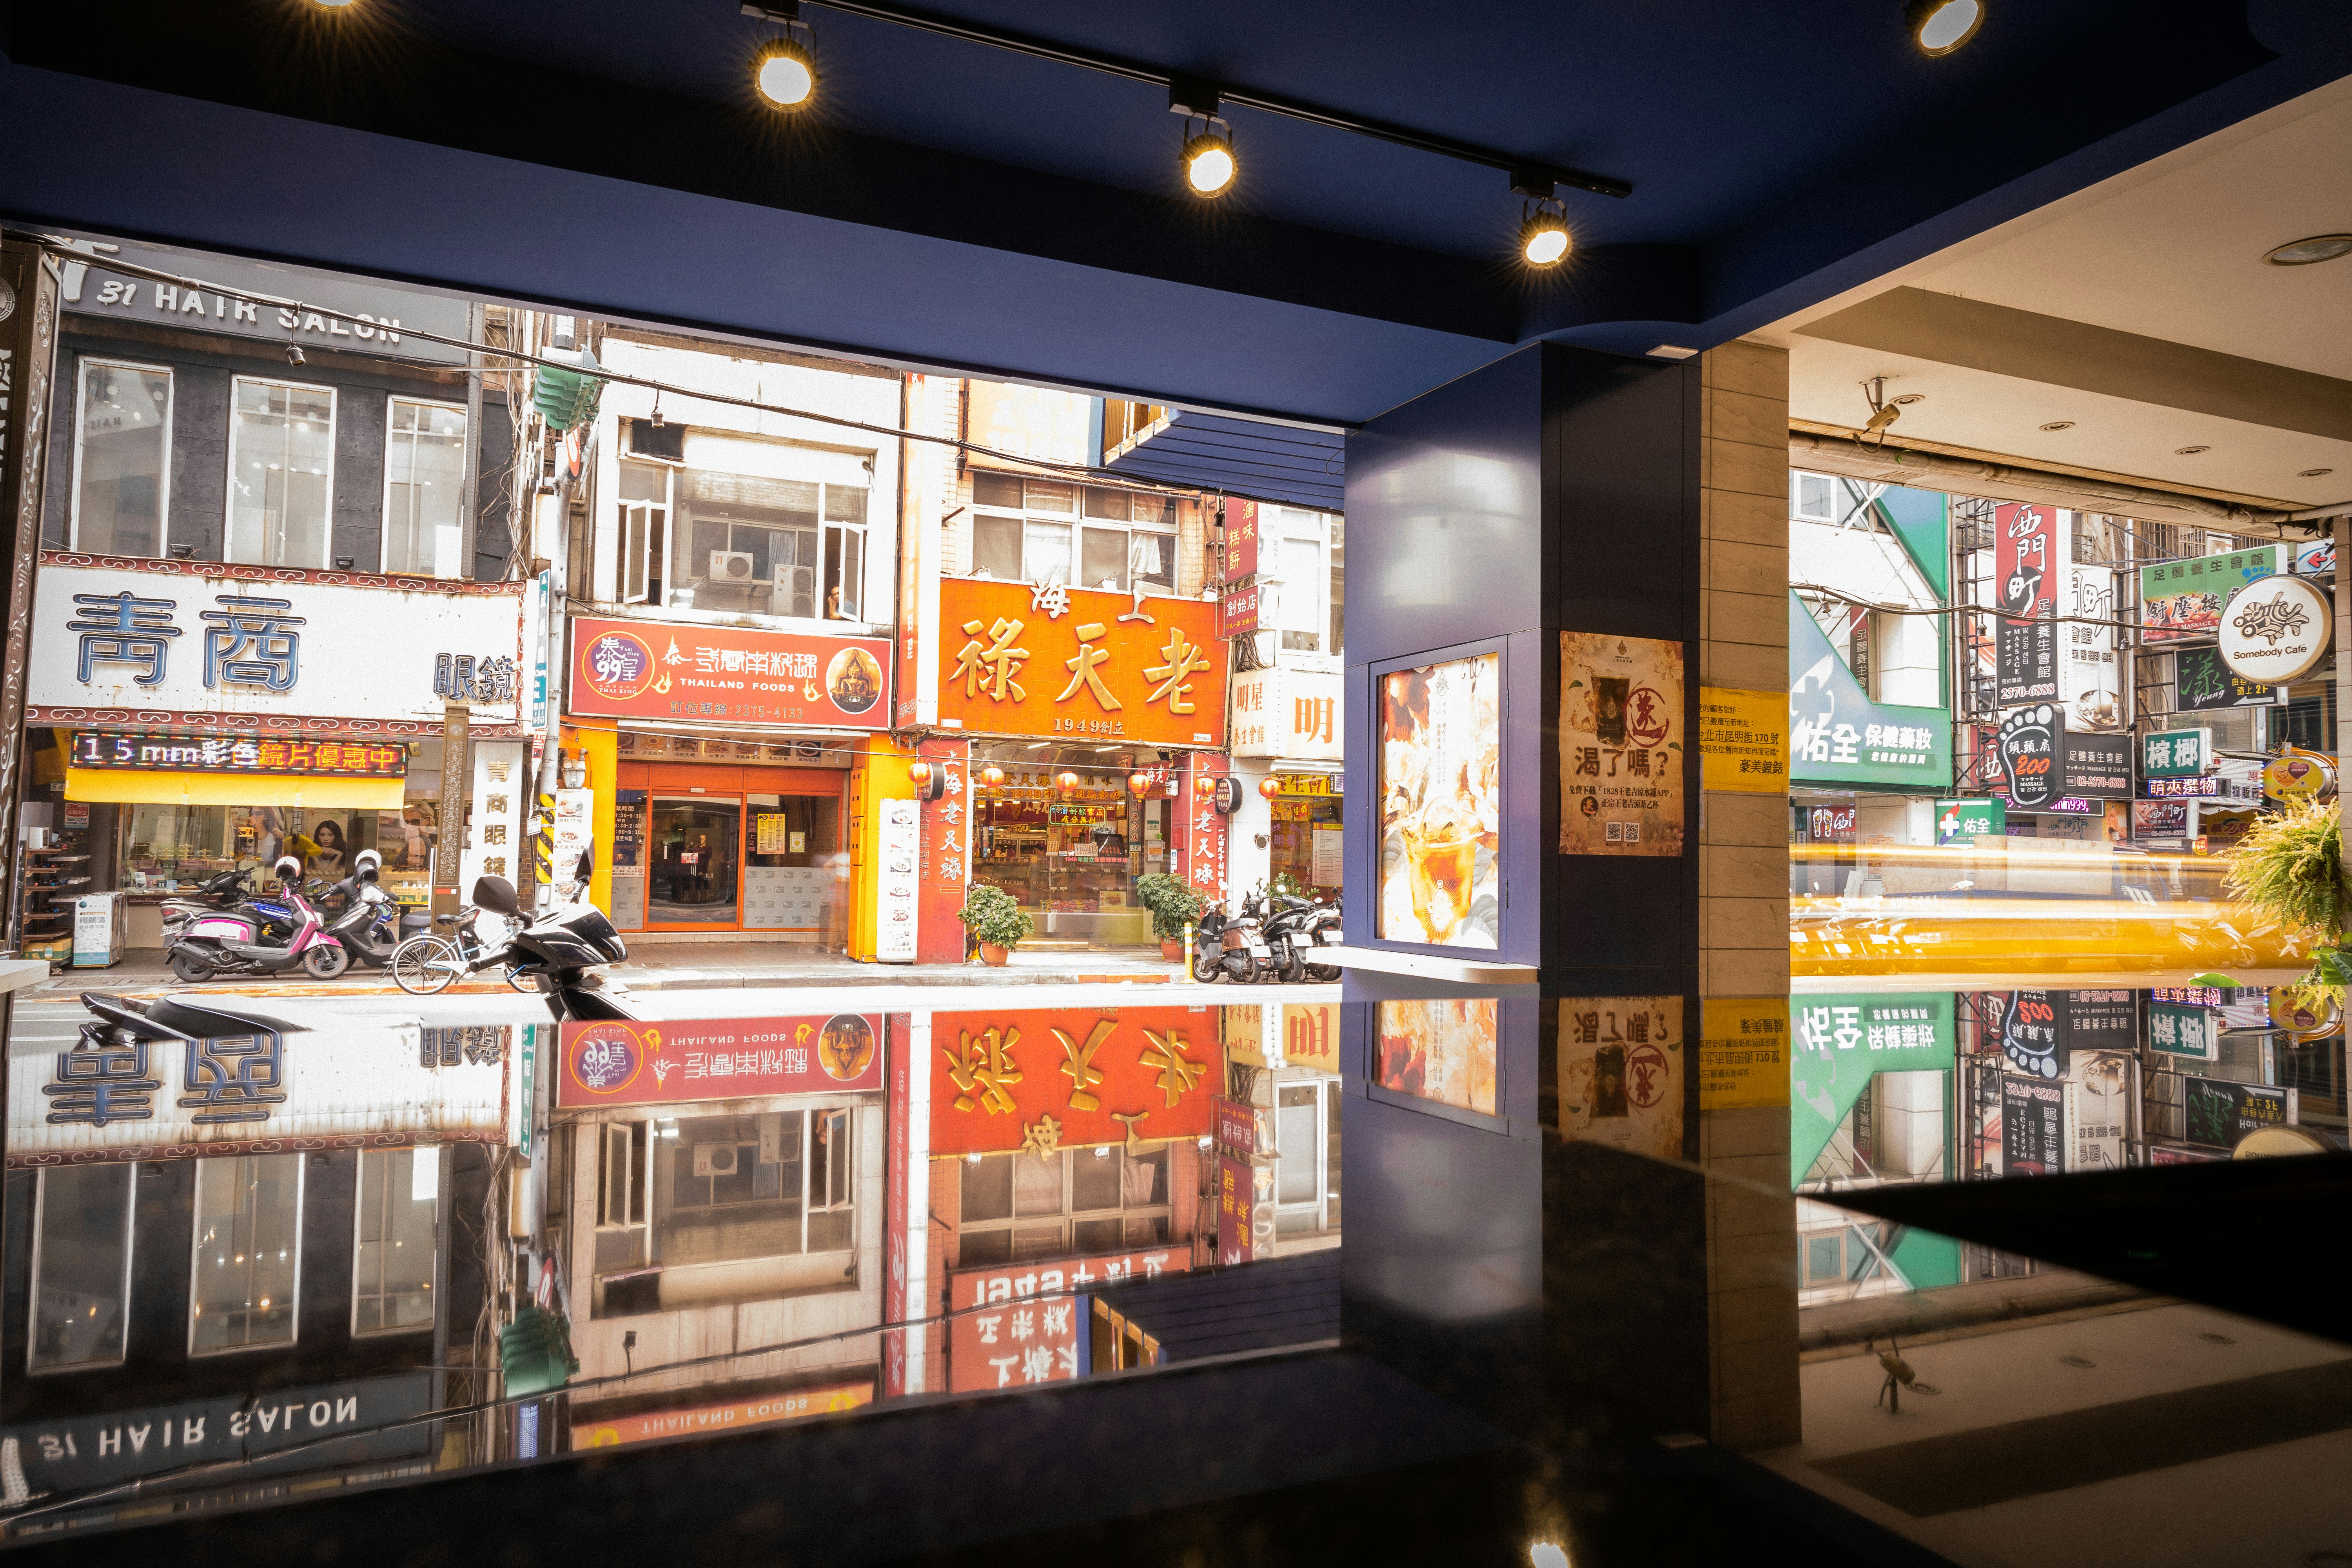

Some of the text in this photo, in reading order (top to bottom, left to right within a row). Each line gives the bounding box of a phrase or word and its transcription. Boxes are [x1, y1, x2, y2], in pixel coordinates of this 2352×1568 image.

[97, 281, 400, 344] 31 HAIR SALON
[1242, 500, 1255, 540] 滷味
[1228, 527, 1240, 571] 糕餅
[2007, 505, 2047, 617] 西門町
[2154, 552, 2264, 582] 足體養生會館
[1227, 593, 1256, 617] 創始店
[1241, 615, 1258, 626] 別無分店
[2181, 621, 2212, 629] MASSAGE
[66, 590, 307, 693] 青商
[2234, 644, 2307, 660] Somebody Café
[432, 652, 515, 702] 眼鏡
[594, 659, 622, 684] 99
[679, 678, 795, 692] THAILAND FOODS
[2000, 682, 2056, 701] 2370-6888
[2237, 686, 2253, 696] 請上
[1236, 681, 1263, 713] 明星
[2192, 689, 2225, 708] Young
[1054, 718, 1125, 736] 1949創立
[1294, 696, 1335, 744] 明
[1234, 725, 1265, 746] 養生會館
[1755, 733, 1769, 742] 170
[1771, 733, 1780, 745] 號
[1801, 720, 1862, 763] 佑全
[1864, 723, 1933, 750] 保健藥妝
[85, 738, 394, 769] 15mm彩色鏡片優惠中
[1575, 746, 1668, 778] 渴了嗎？
[2069, 750, 2123, 764] 足體養生會館
[2147, 737, 2198, 769] 檳榔
[1739, 759, 1784, 774] 豪美鐘錶
[2015, 755, 2051, 775] 200
[1272, 774, 1331, 794] 養生會
[2076, 775, 2126, 788] 02-2370-6888
[483, 760, 511, 878] 青商眼鏡
[2149, 804, 2186, 822] 西門町
[1963, 818, 1990, 833] 佑全
